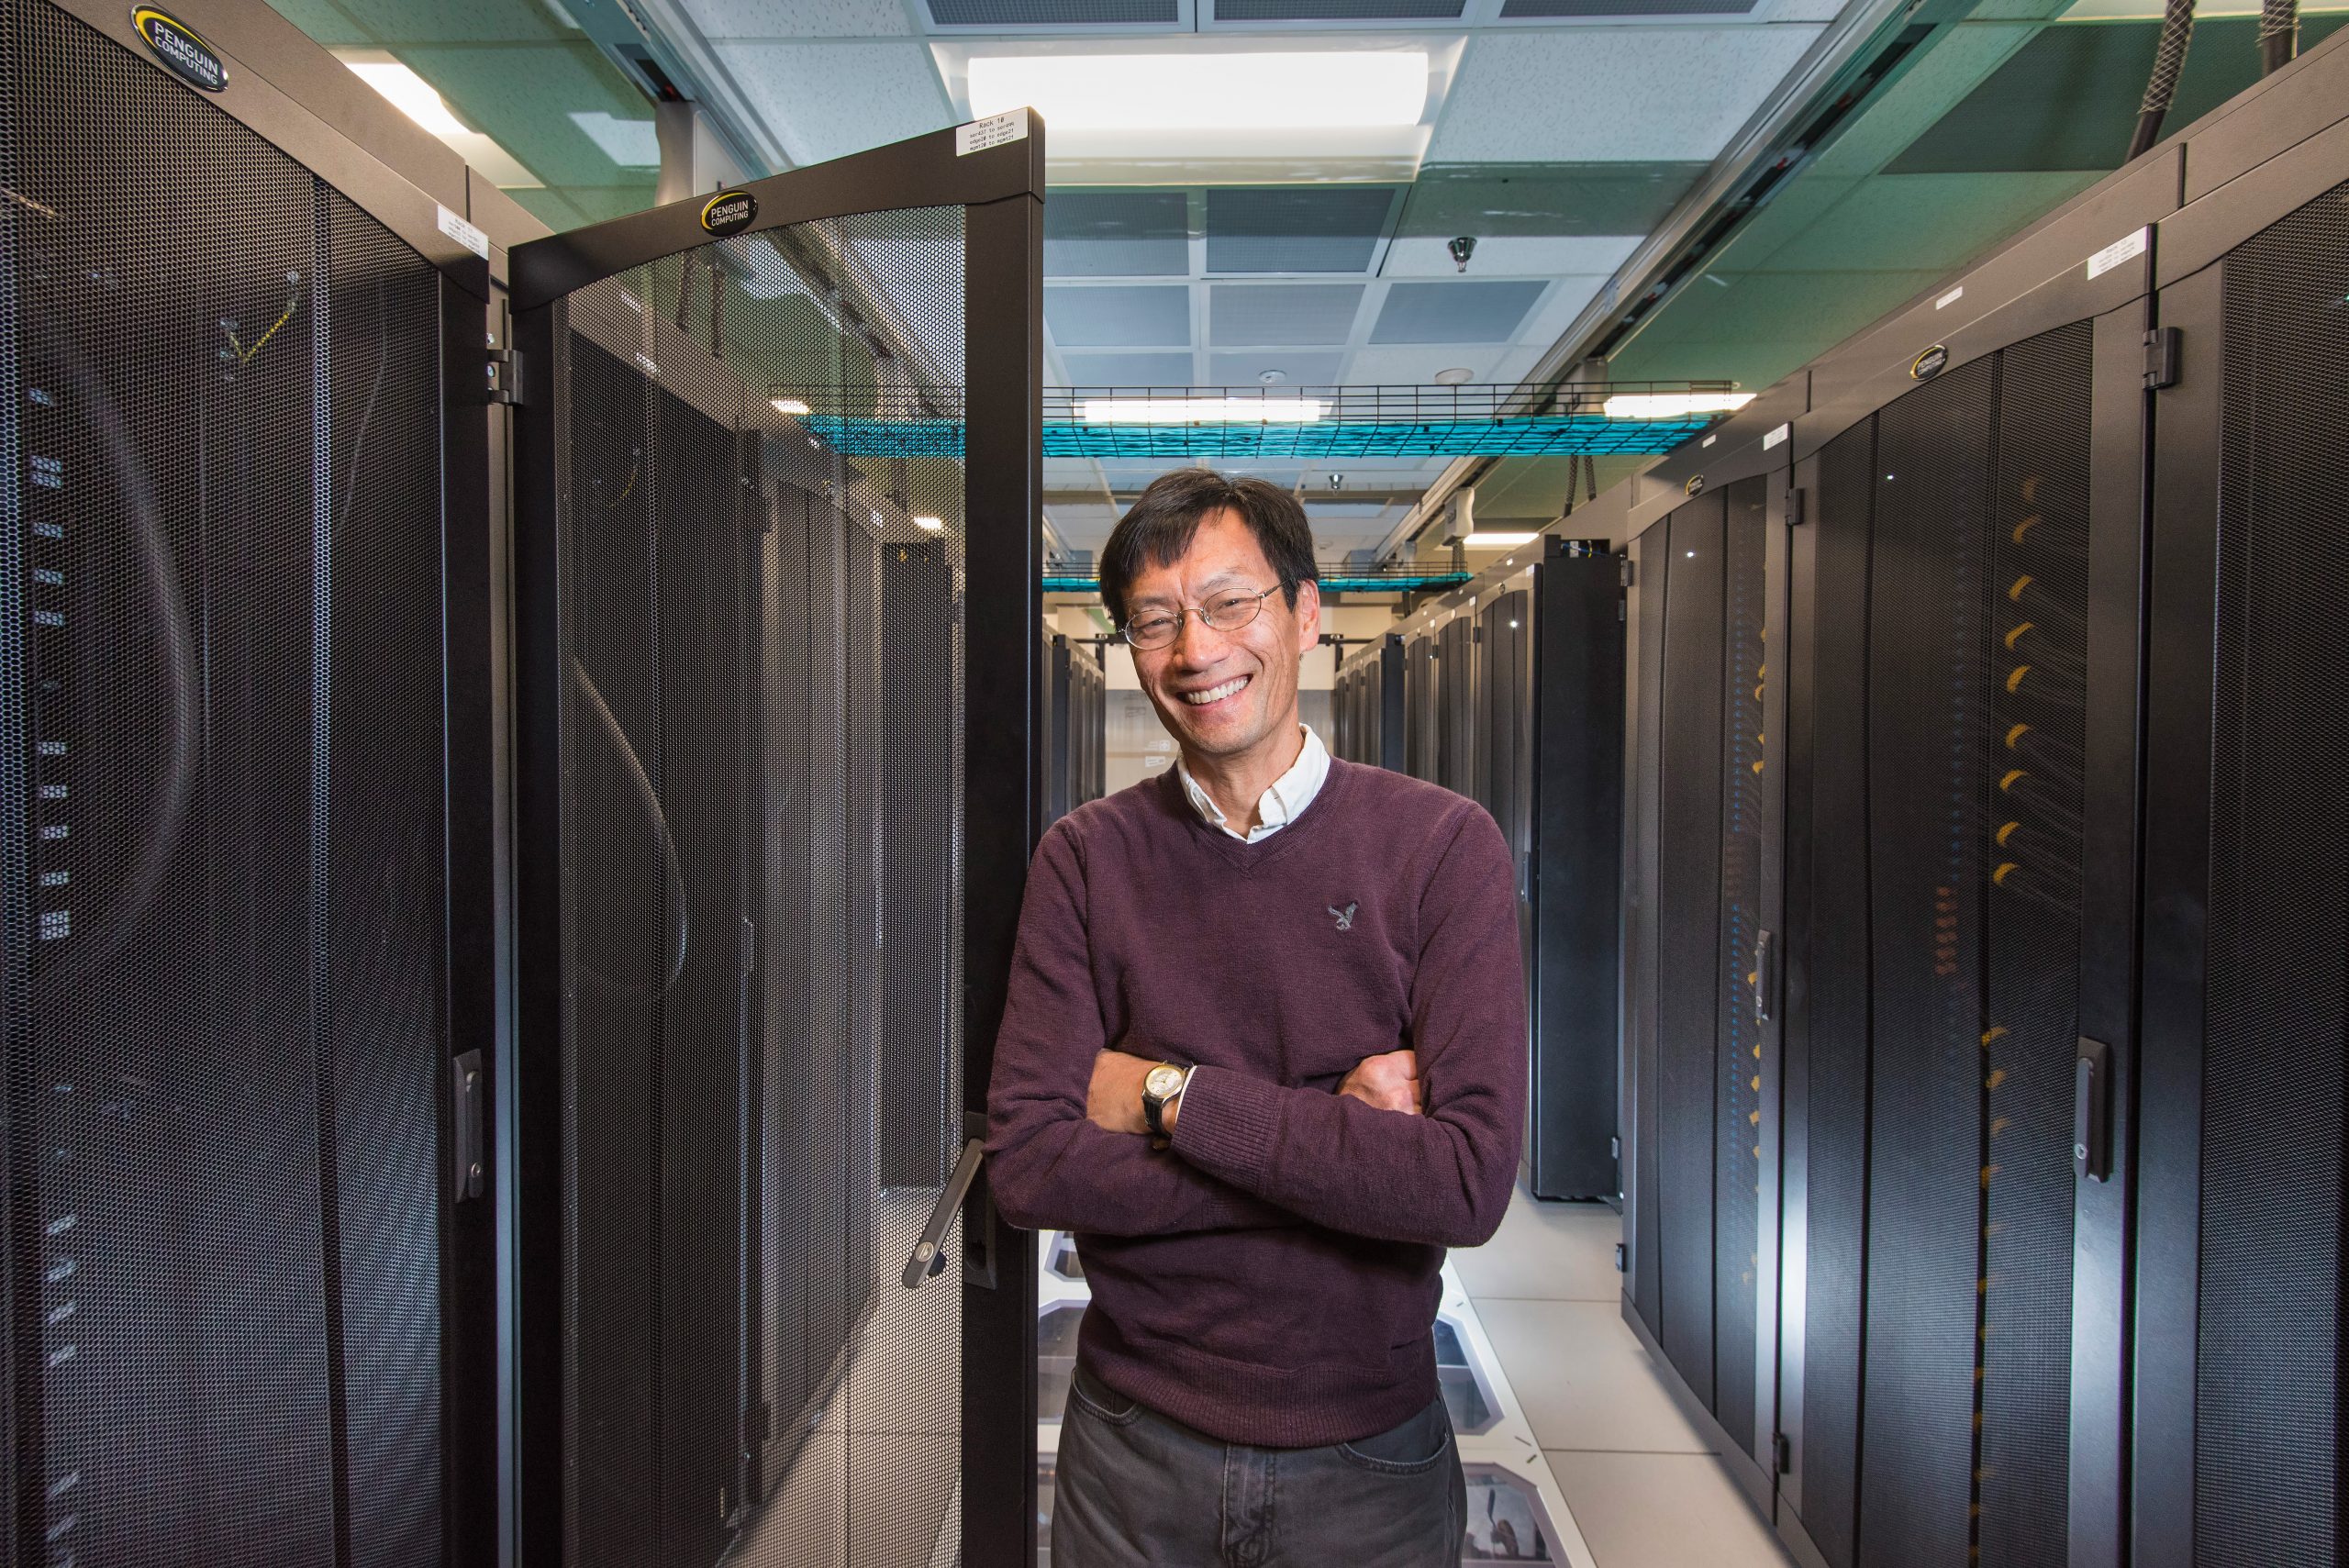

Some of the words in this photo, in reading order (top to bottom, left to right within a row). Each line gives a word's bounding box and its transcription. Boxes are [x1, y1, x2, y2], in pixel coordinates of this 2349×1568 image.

[154, 21, 218, 75] PENGUIN
[155, 36, 217, 84] COMPUTING
[979, 120, 994, 128] Rack
[711, 199, 749, 218] PENGUIN
[711, 210, 749, 227] COMPUTING
